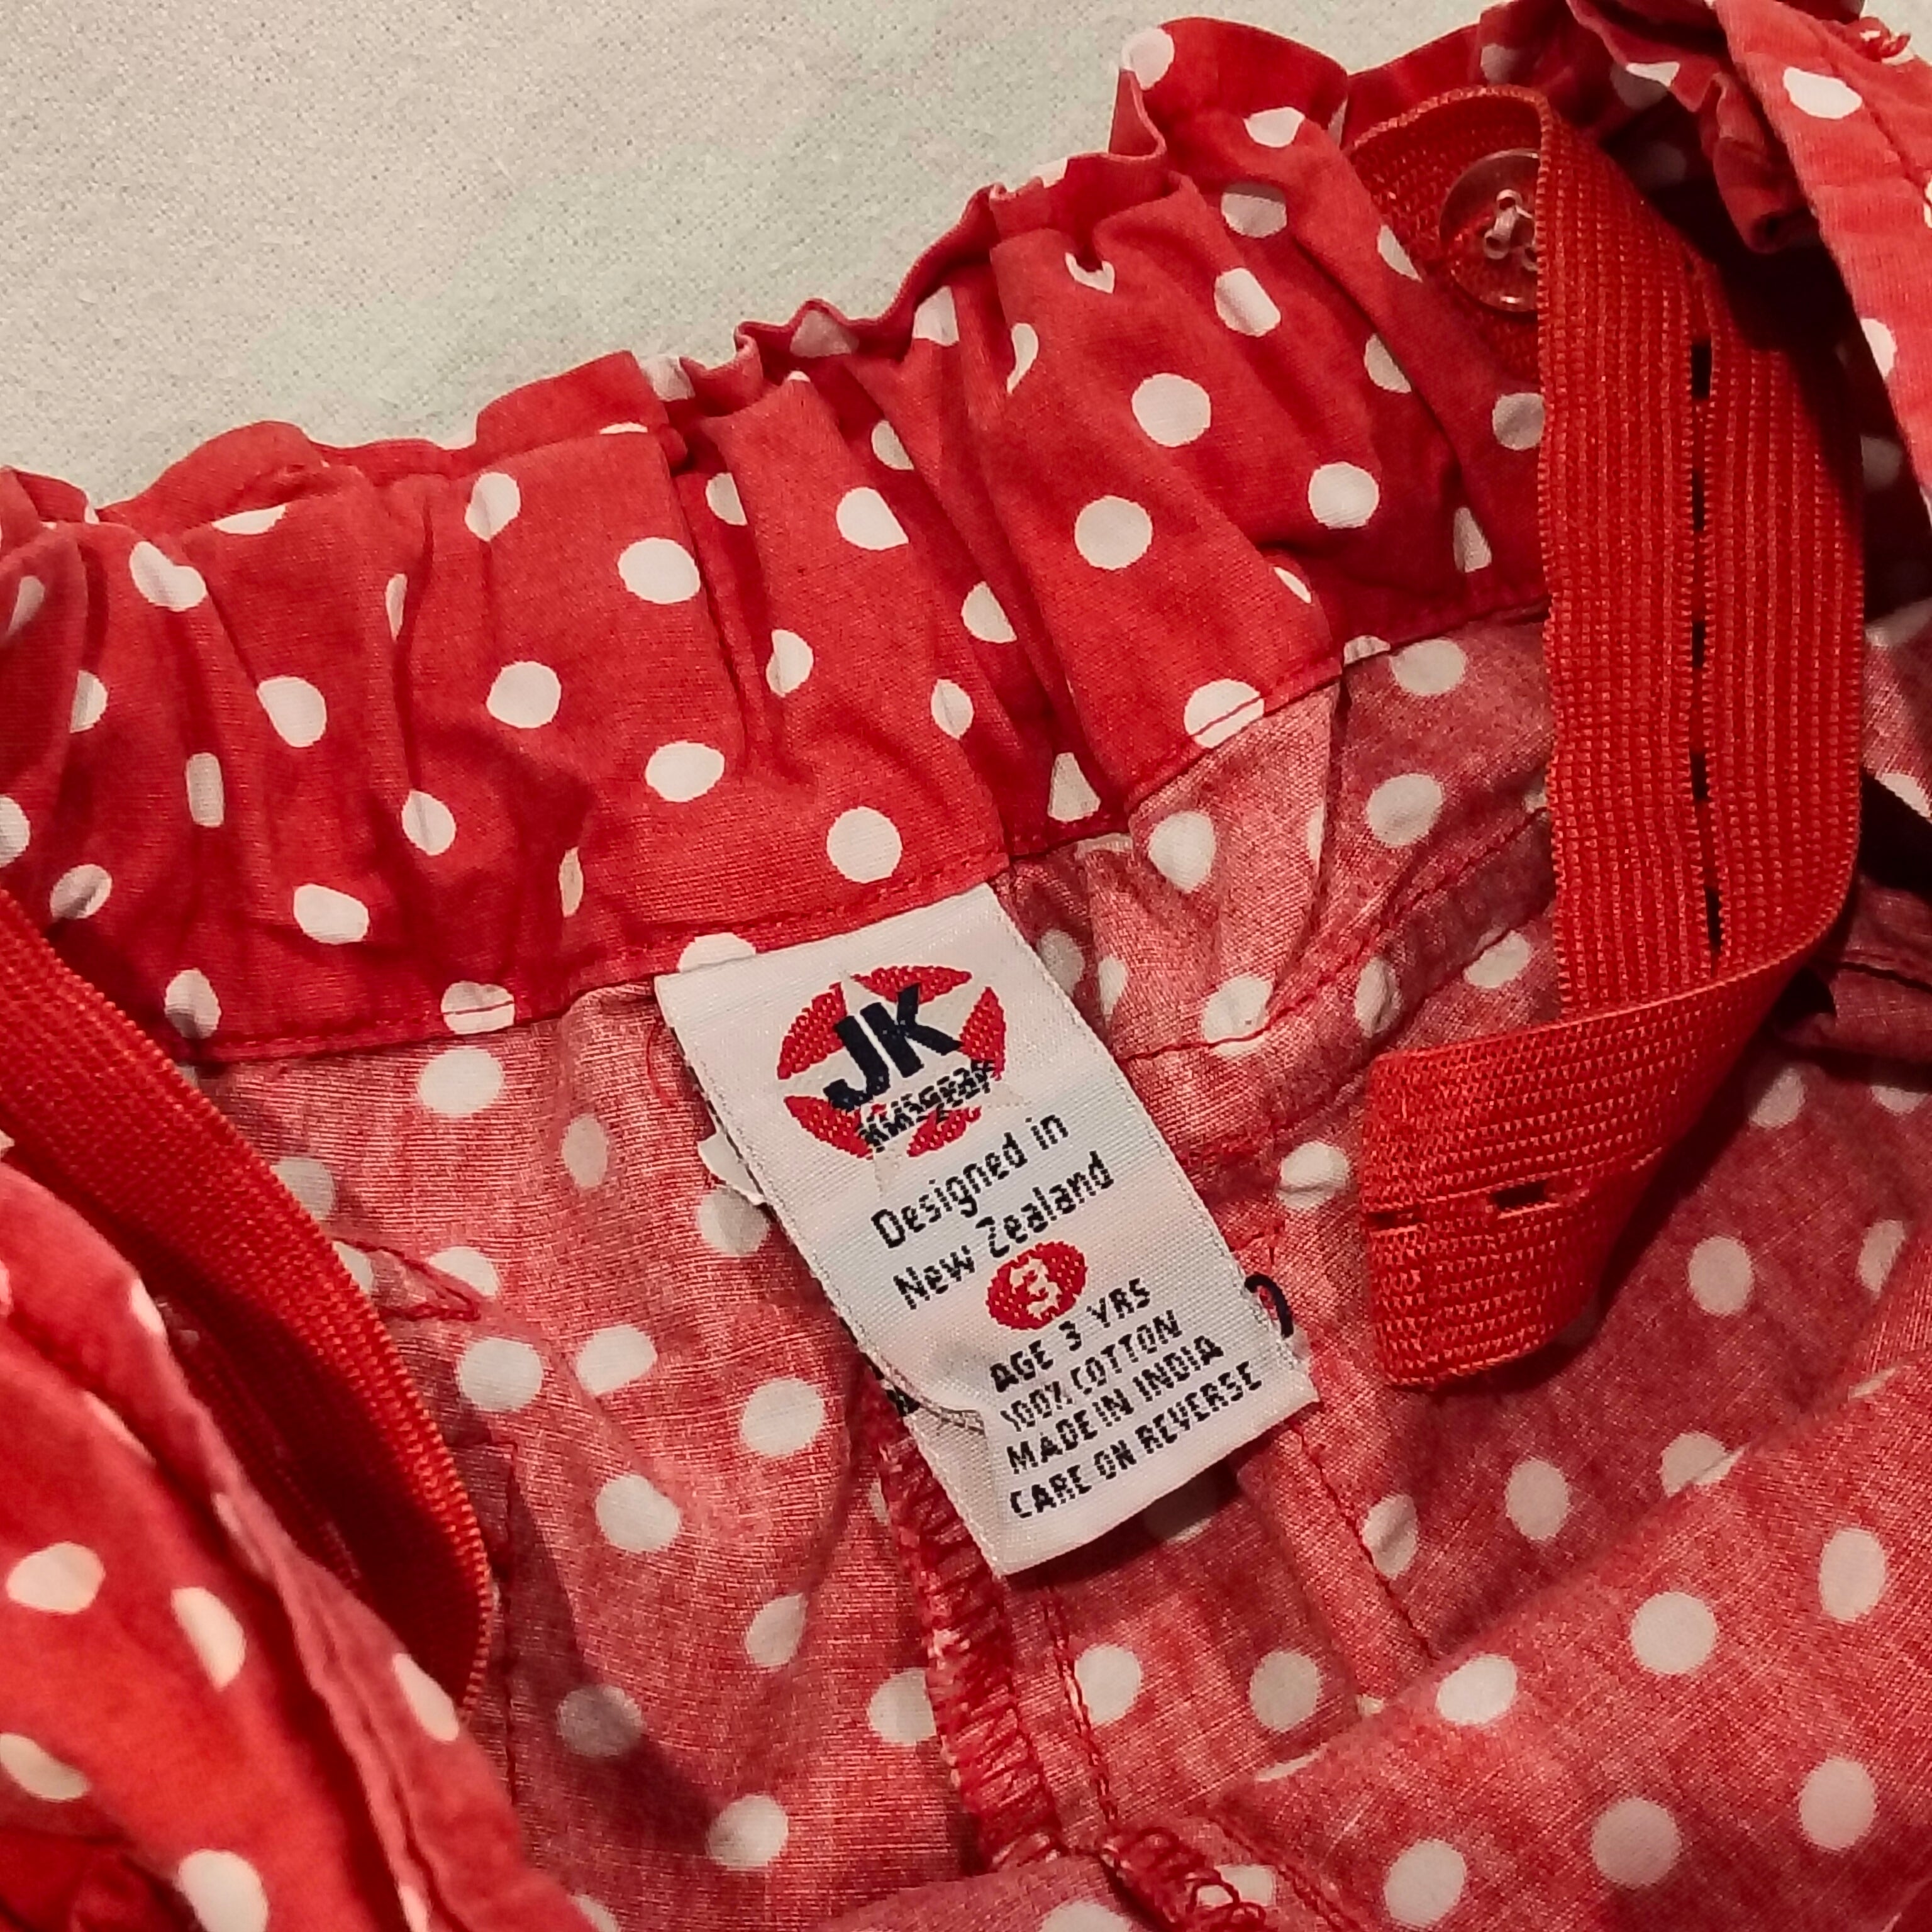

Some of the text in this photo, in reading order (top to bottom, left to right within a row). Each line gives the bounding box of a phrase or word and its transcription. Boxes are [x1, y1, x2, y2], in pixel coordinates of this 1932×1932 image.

[823, 983, 962, 1112] JK
[871, 1114, 1069, 1249] Designed in
[893, 1150, 1114, 1310] New Zealand
[989, 1277, 1151, 1392] AGE 3 YRS
[1009, 1258, 1060, 1319] 3
[1000, 1309, 1182, 1432] 100% COTTON
[1006, 1335, 1224, 1474] MADE IN INDIA
[1010, 1361, 1262, 1518] CARE ON REVERSE
